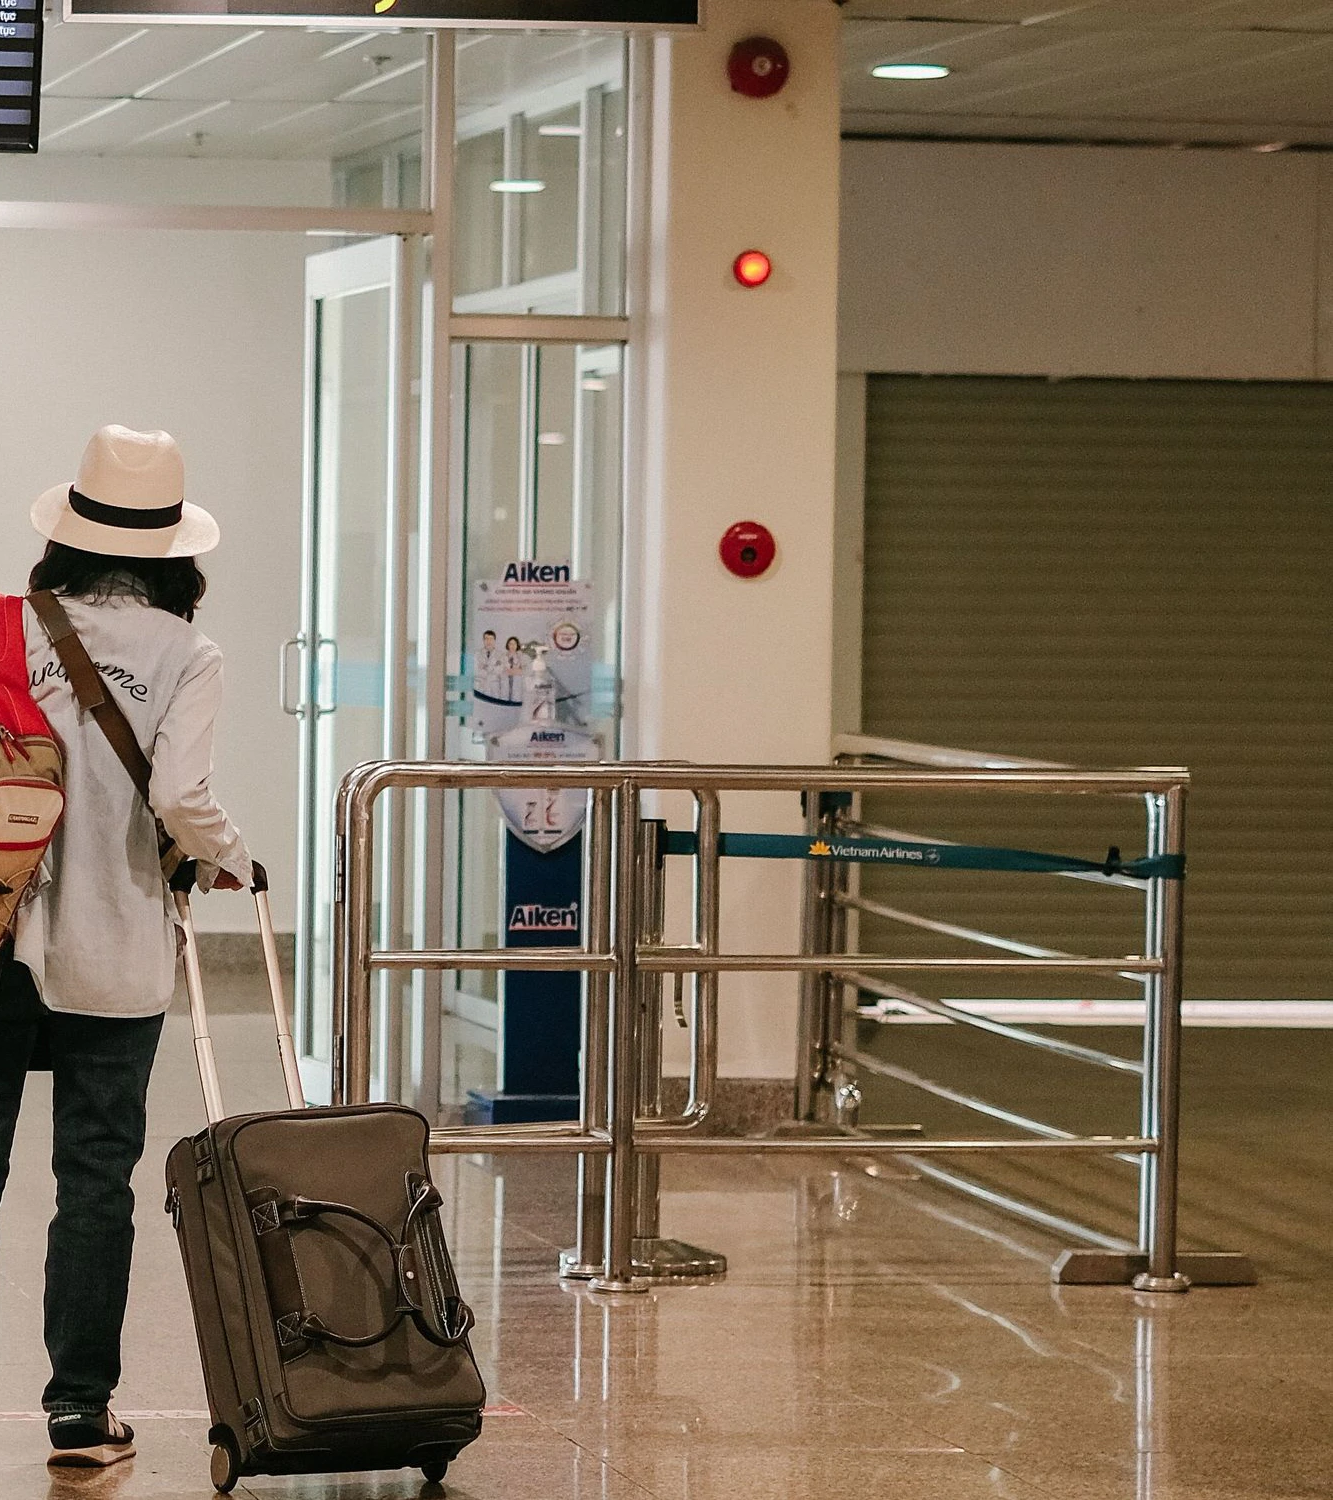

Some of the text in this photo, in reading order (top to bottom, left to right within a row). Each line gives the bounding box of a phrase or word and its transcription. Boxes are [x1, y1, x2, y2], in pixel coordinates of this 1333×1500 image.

[504, 562, 570, 583] Aiken
[530, 731, 565, 743] Aiken
[832, 844, 923, 860] Vietnam Airlines
[511, 905, 576, 928] Aiken
